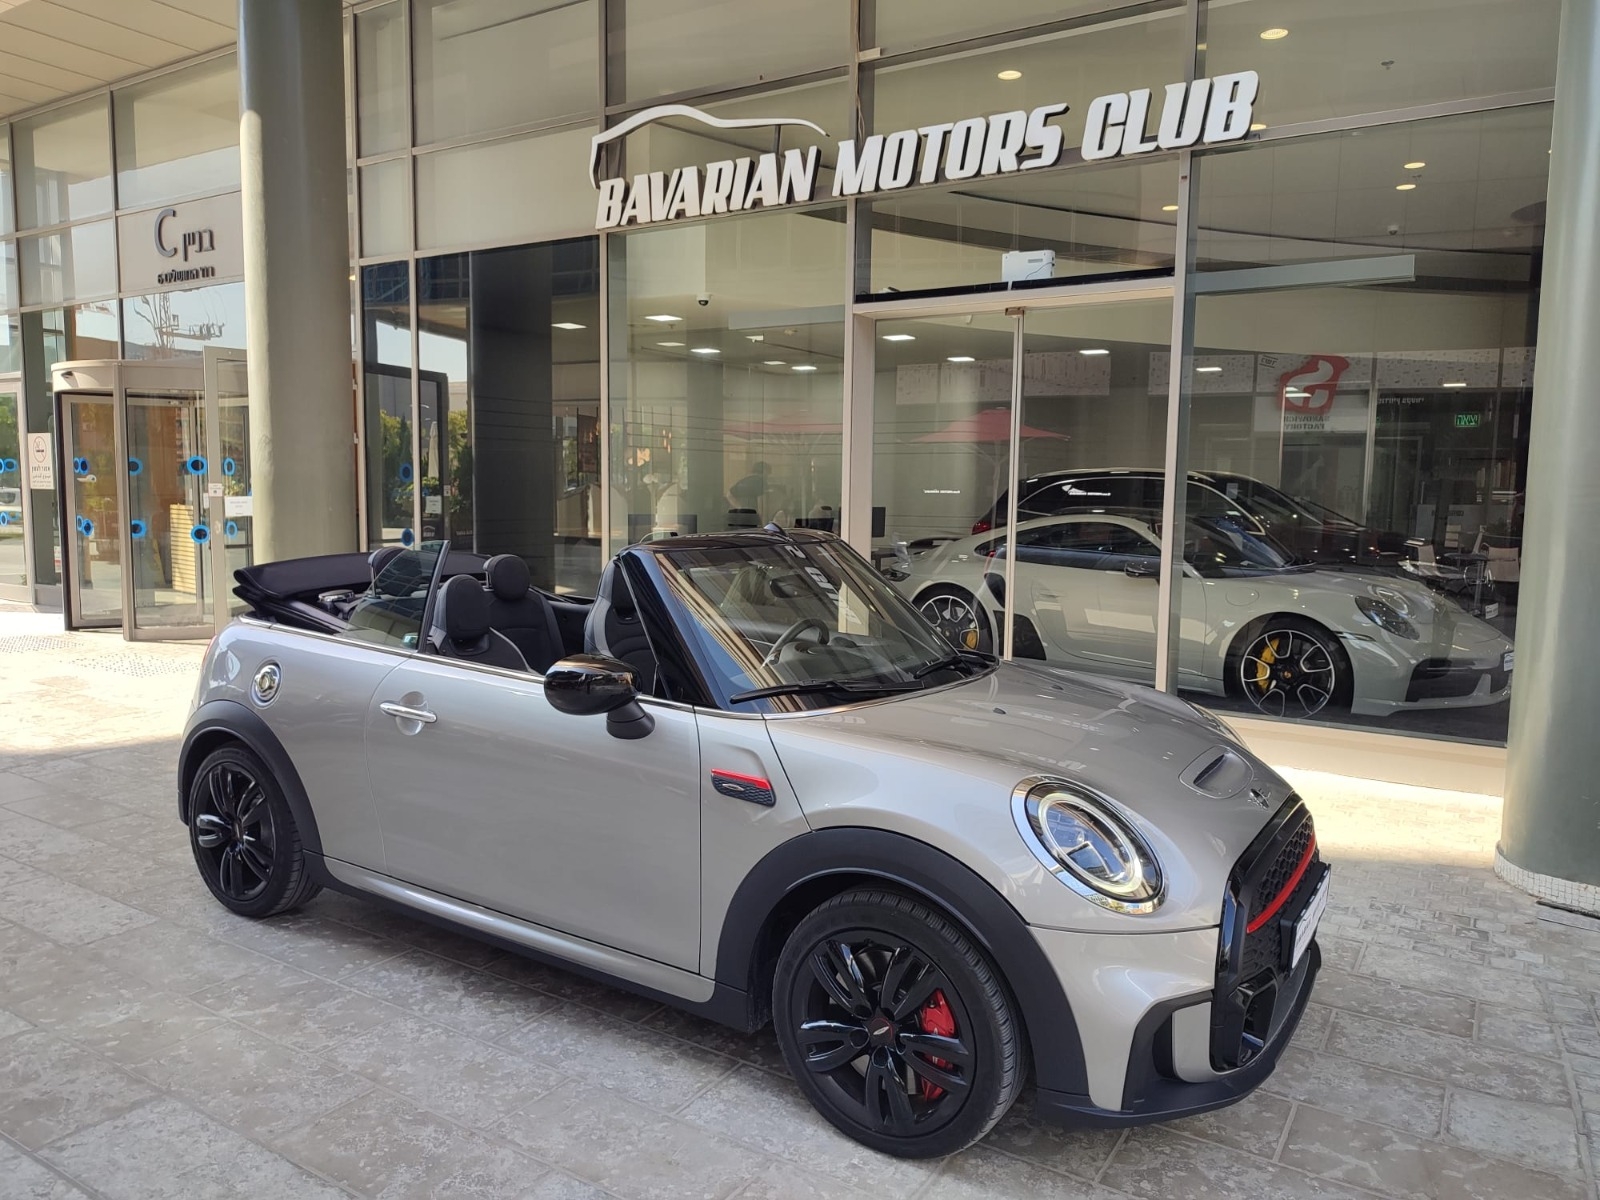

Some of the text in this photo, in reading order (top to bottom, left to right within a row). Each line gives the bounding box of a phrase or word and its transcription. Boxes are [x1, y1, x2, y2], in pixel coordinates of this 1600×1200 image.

[595, 70, 1259, 230] BAVARIAN MOTORS CLUB
[154, 208, 215, 262] בניין C
[1457, 414, 1478, 425] יציאה
